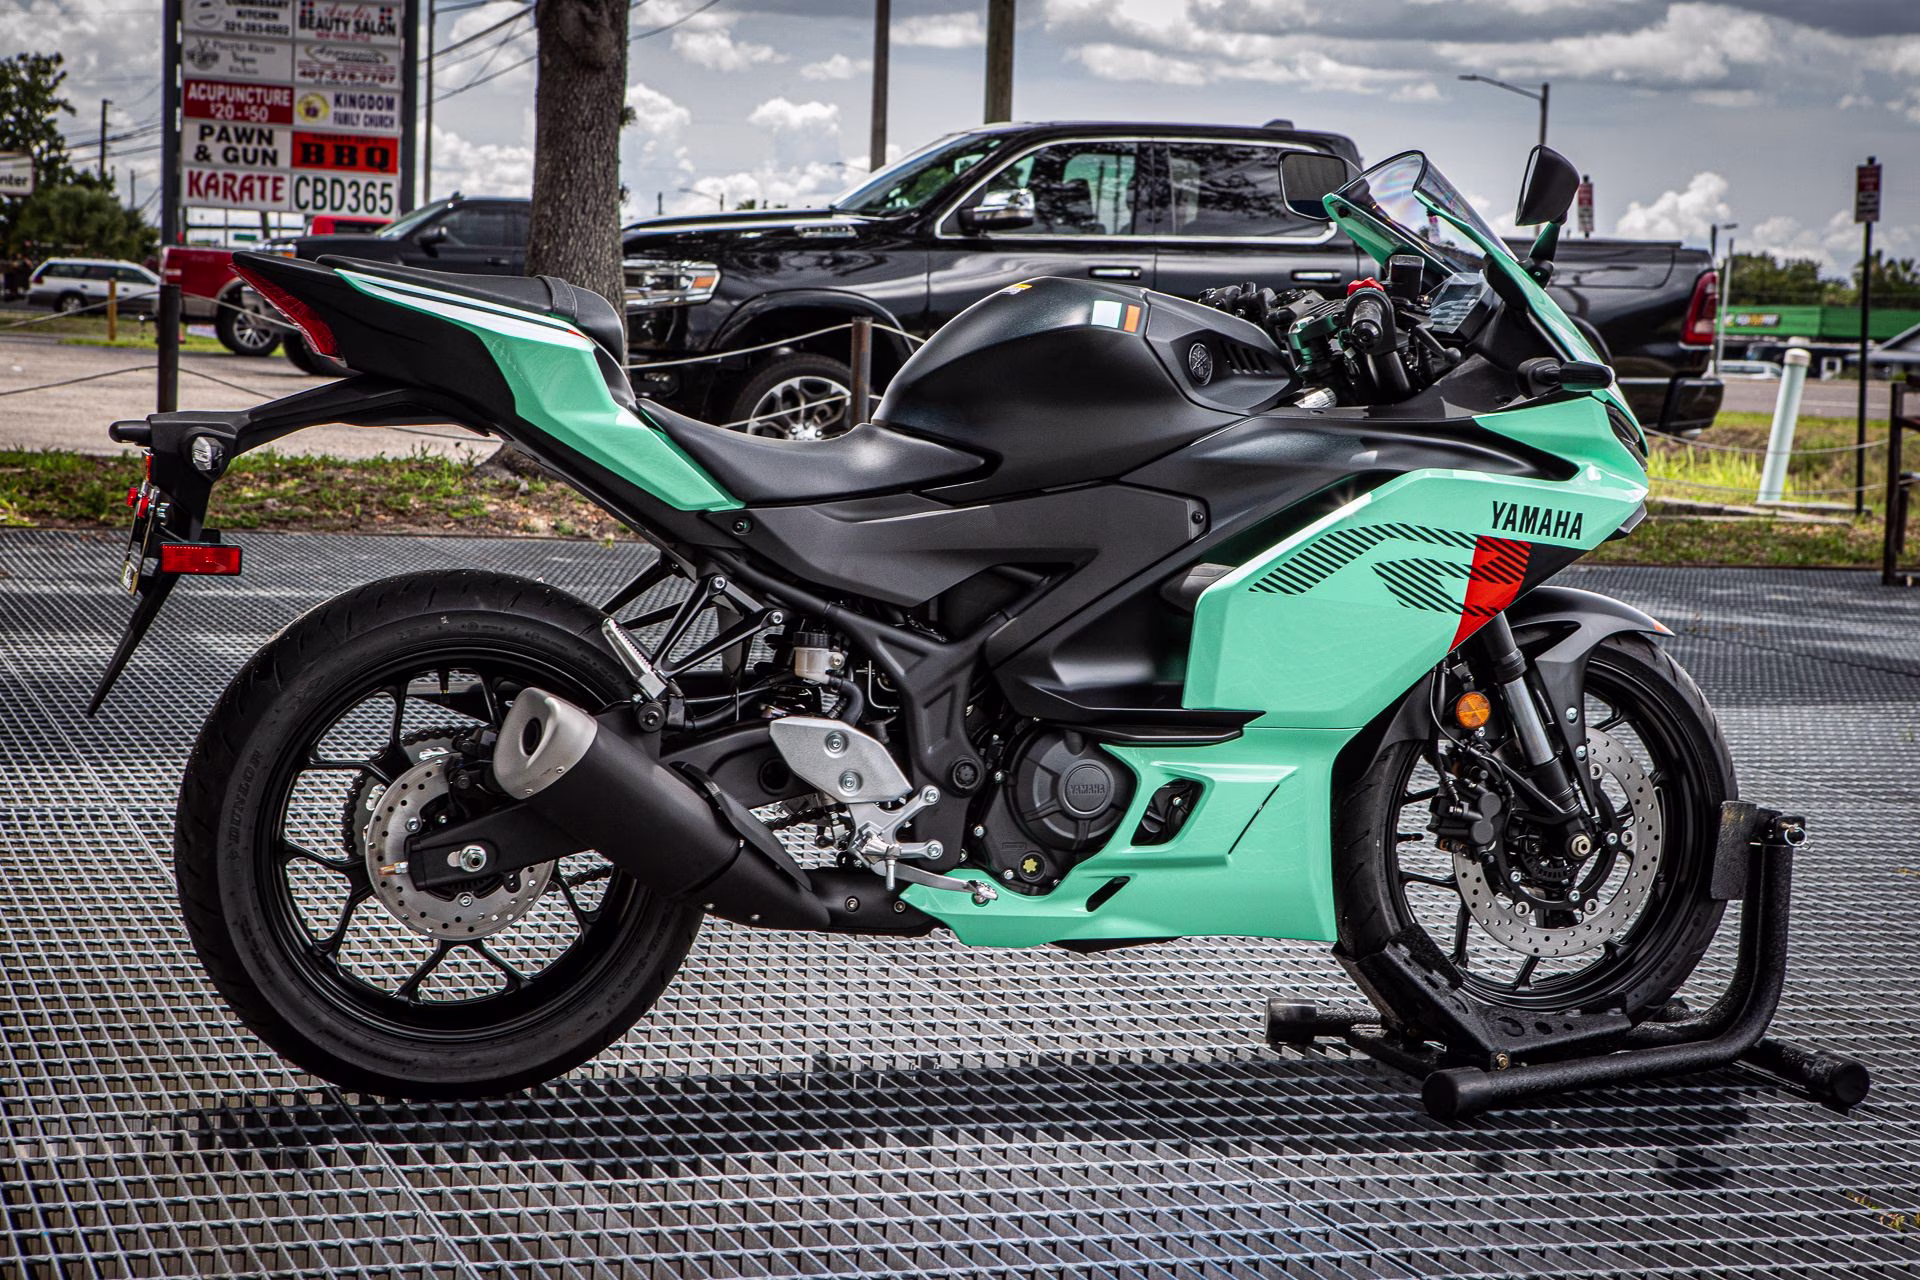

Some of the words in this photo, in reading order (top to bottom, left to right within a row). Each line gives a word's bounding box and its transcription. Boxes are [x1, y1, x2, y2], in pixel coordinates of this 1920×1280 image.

[236, 9, 279, 20] KITCHEN
[299, 15, 350, 33] BEAUTY
[353, 20, 396, 36] SALON
[187, 82, 291, 107] ACUPUNCTURE
[333, 92, 396, 111] KINGDOM
[333, 112, 360, 127] FAMILY
[363, 113, 395, 129] CHURCH
[199, 124, 274, 147] PAWN
[194, 143, 212, 163] &
[222, 146, 278, 167] GUN
[302, 143, 389, 171] BBQ
[187, 169, 285, 204] KARATE
[294, 175, 393, 215] CBD365
[1491, 500, 1584, 541] YAMAHA
[1070, 783, 1106, 795] YAMAHA
